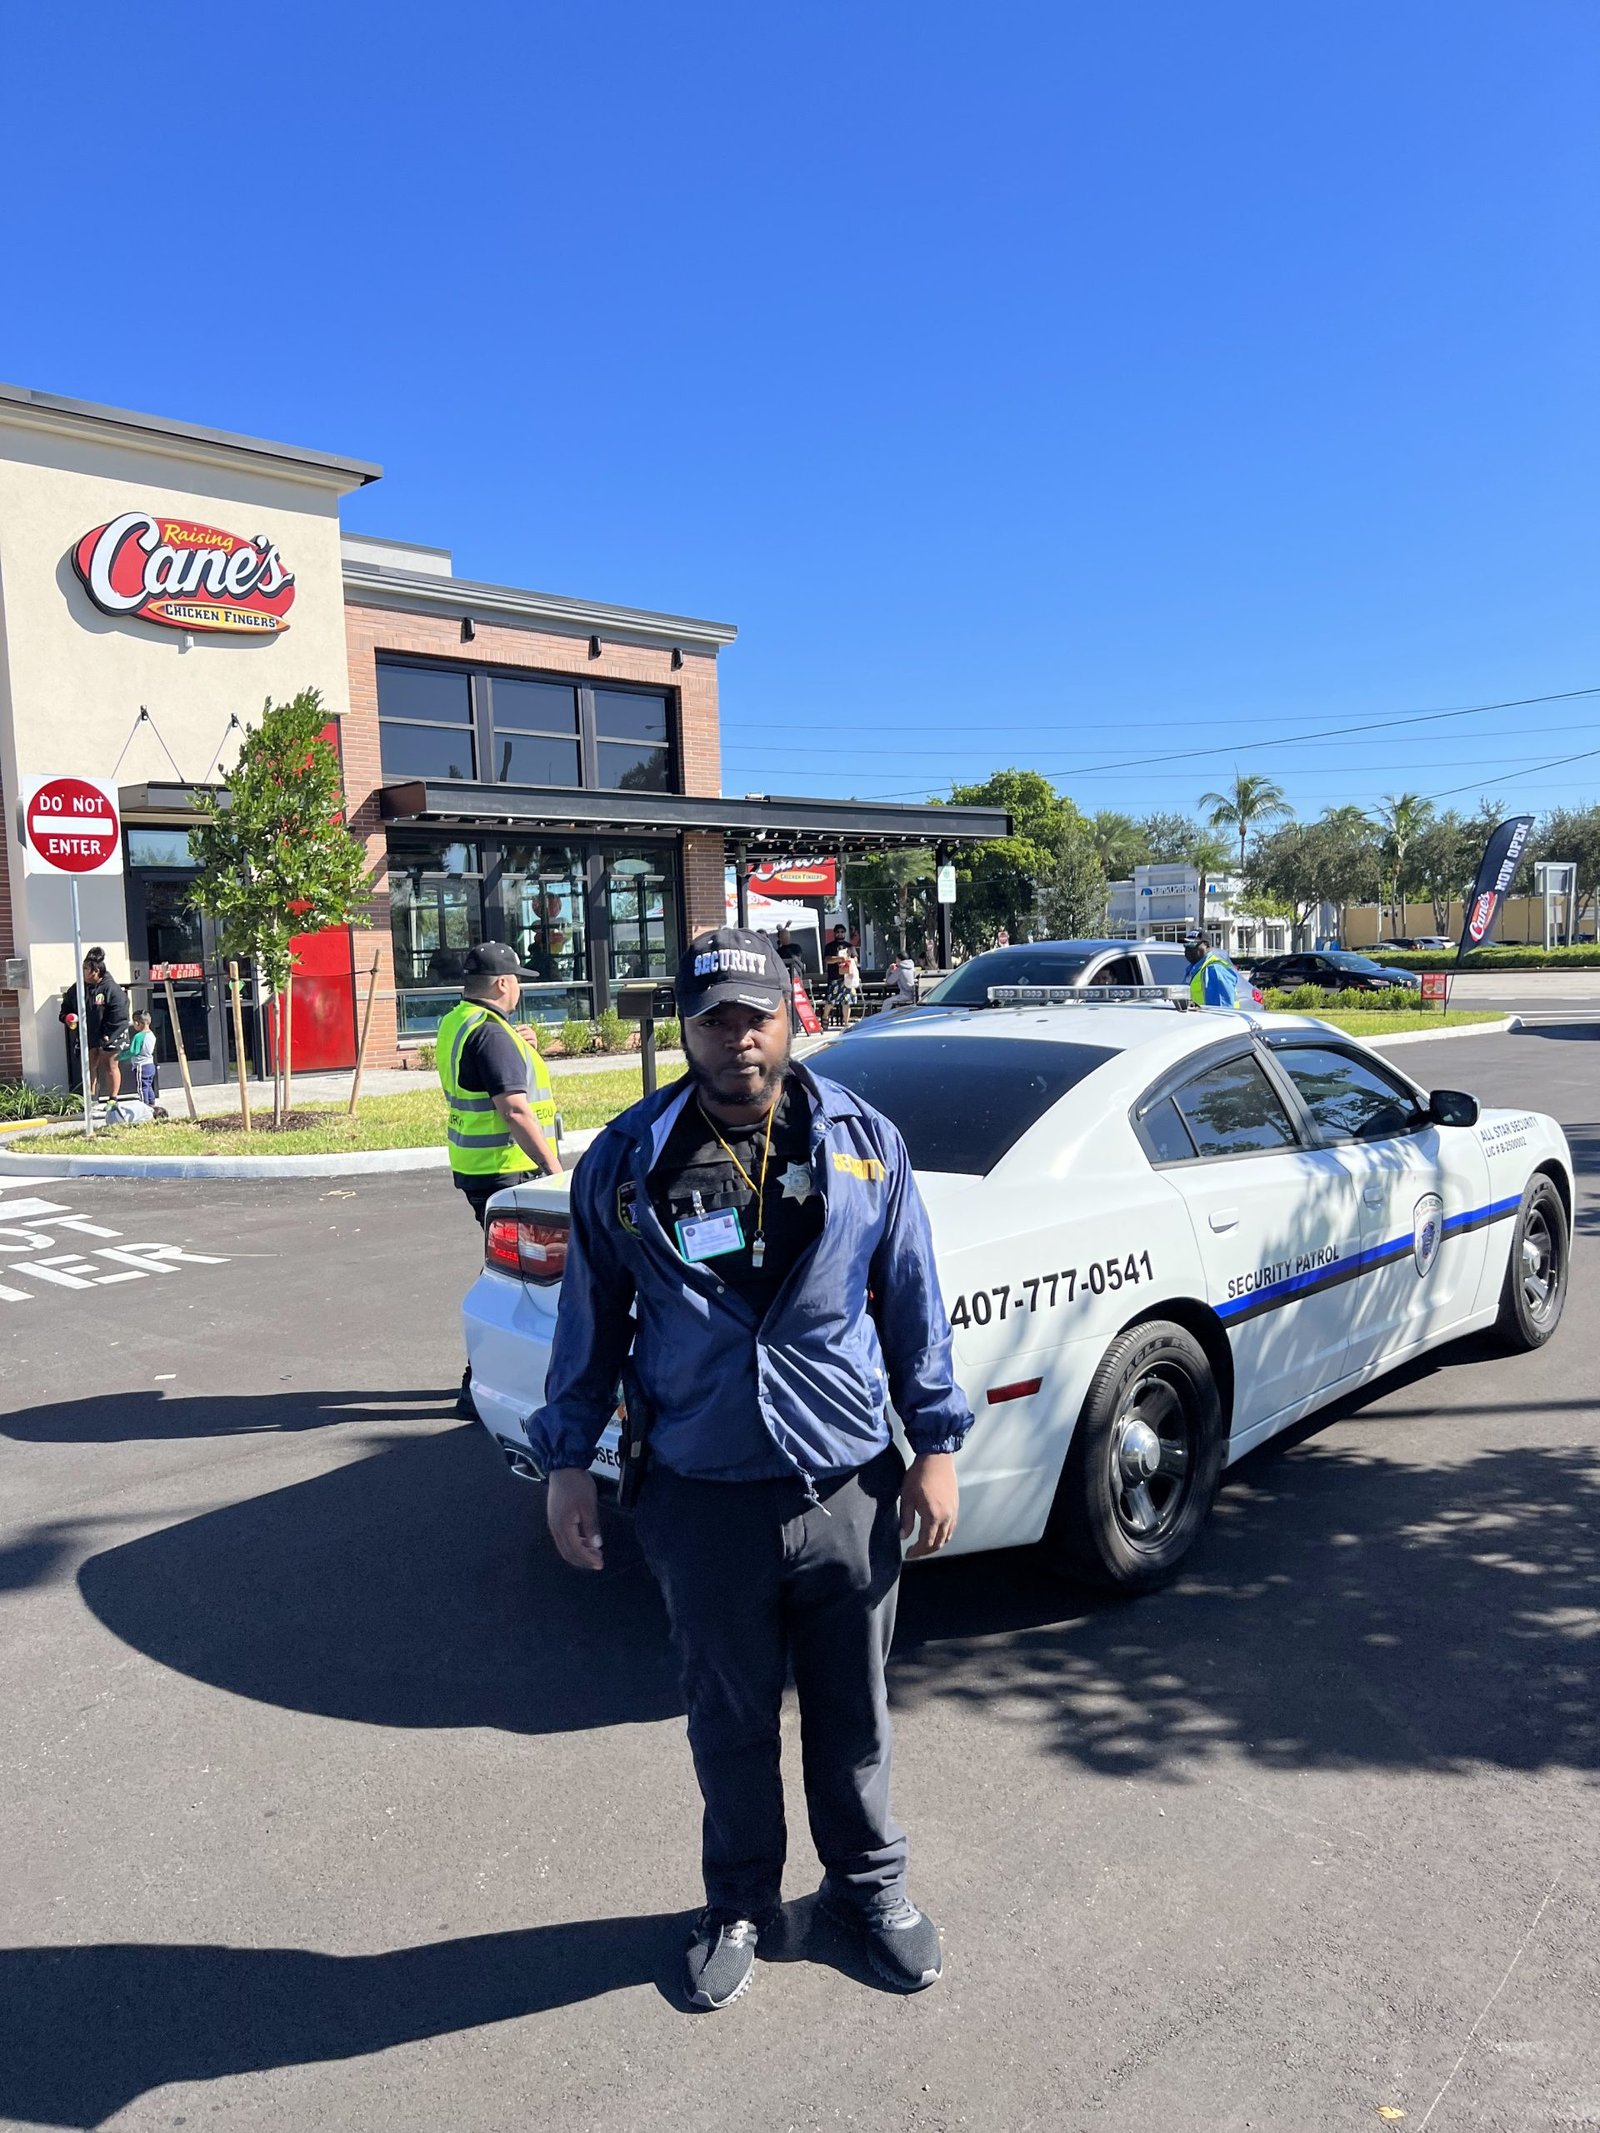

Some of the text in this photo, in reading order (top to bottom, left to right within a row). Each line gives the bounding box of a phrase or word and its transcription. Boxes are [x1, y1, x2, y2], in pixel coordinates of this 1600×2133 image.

[163, 524, 235, 552] Raising
[90, 512, 295, 610] Cane's
[165, 603, 277, 628] CHICKEN FINGERS
[40, 795, 104, 813] DO NOT
[48, 839, 101, 855] ENTER
[1495, 823, 1529, 891] NOW OPEN
[1470, 891, 1490, 940] Cane's
[151, 970, 177, 980] REL
[694, 949, 766, 976] SECURITY
[536, 1109, 554, 1120] ECU
[1480, 1116, 1539, 1142] ALL STAR SECURITY
[0, 1213, 124, 1252] OT
[1228, 1244, 1340, 1298] SECURITY PATROL
[950, 1249, 1154, 1329] 407-777-0541
